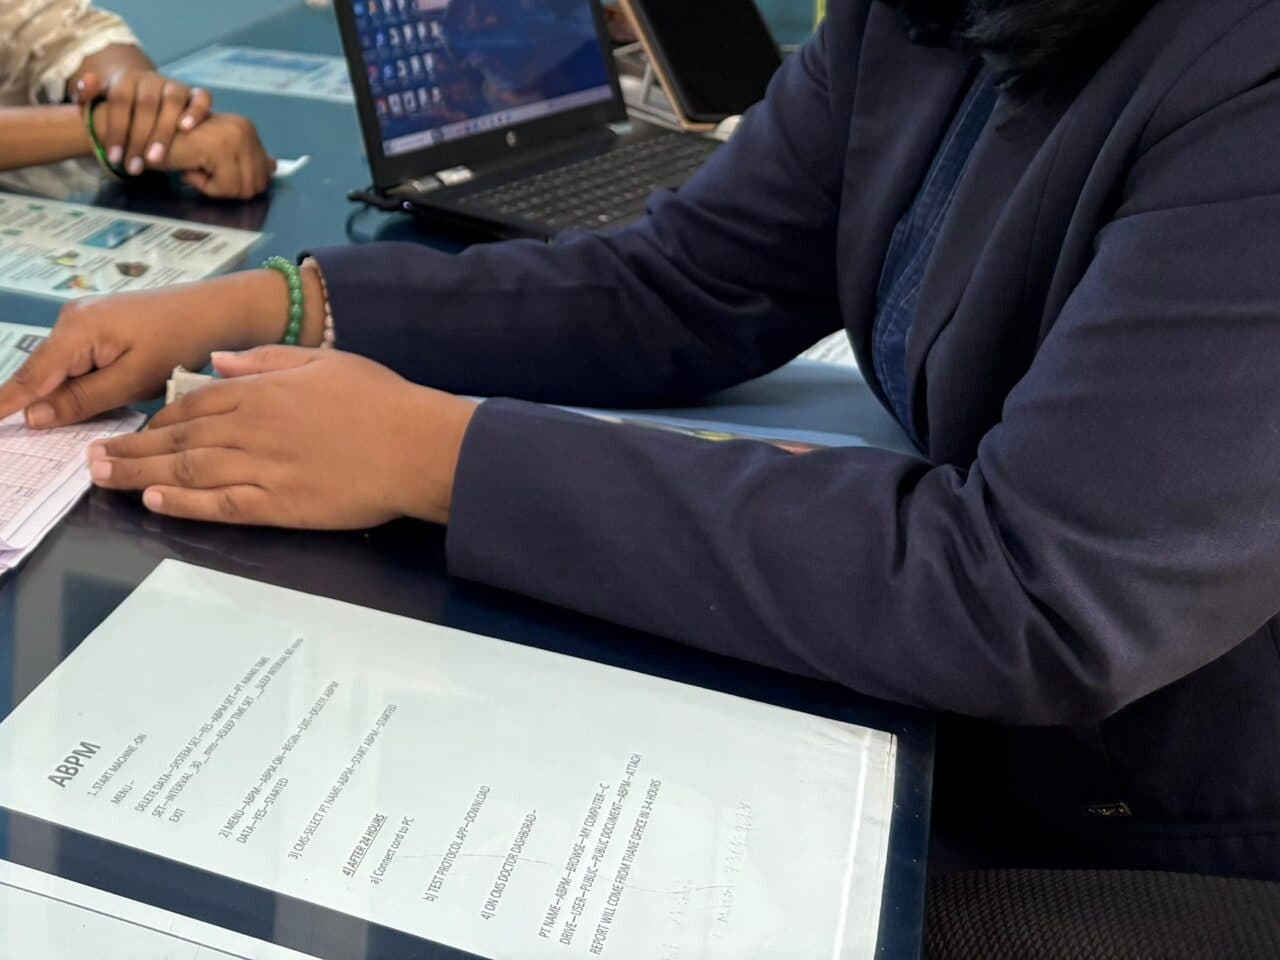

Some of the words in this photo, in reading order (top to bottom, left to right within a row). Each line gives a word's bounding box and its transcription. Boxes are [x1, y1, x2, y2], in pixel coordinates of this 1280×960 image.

[47, 741, 100, 787] ABPM
[91, 770, 114, 790] START
[108, 744, 138, 772] MACHINE
[133, 789, 159, 812] DELETE
[645, 778, 661, 801] HOURS
[167, 807, 185, 823] EXIT
[317, 802, 330, 814] PT
[640, 799, 654, 811] 3-4
[364, 812, 388, 838] HOURS
[510, 813, 536, 853] DASHBORAD
[630, 817, 647, 840] OFFICE
[358, 835, 375, 848] 24
[372, 848, 396, 876] Connect
[390, 832, 404, 849] cord
[400, 815, 414, 826] PC
[621, 839, 640, 863] THANE
[346, 844, 369, 869] AFTER
[426, 874, 444, 893] TEST
[436, 840, 463, 876] PROTOCOL
[497, 852, 520, 882] DOCTOR
[614, 861, 631, 884] FROM
[489, 881, 506, 898] CMS
[606, 882, 624, 906] COME
[483, 897, 499, 911] ON
[599, 906, 616, 924] WILL
[537, 926, 551, 938] PT
[589, 923, 609, 955] REPORT
